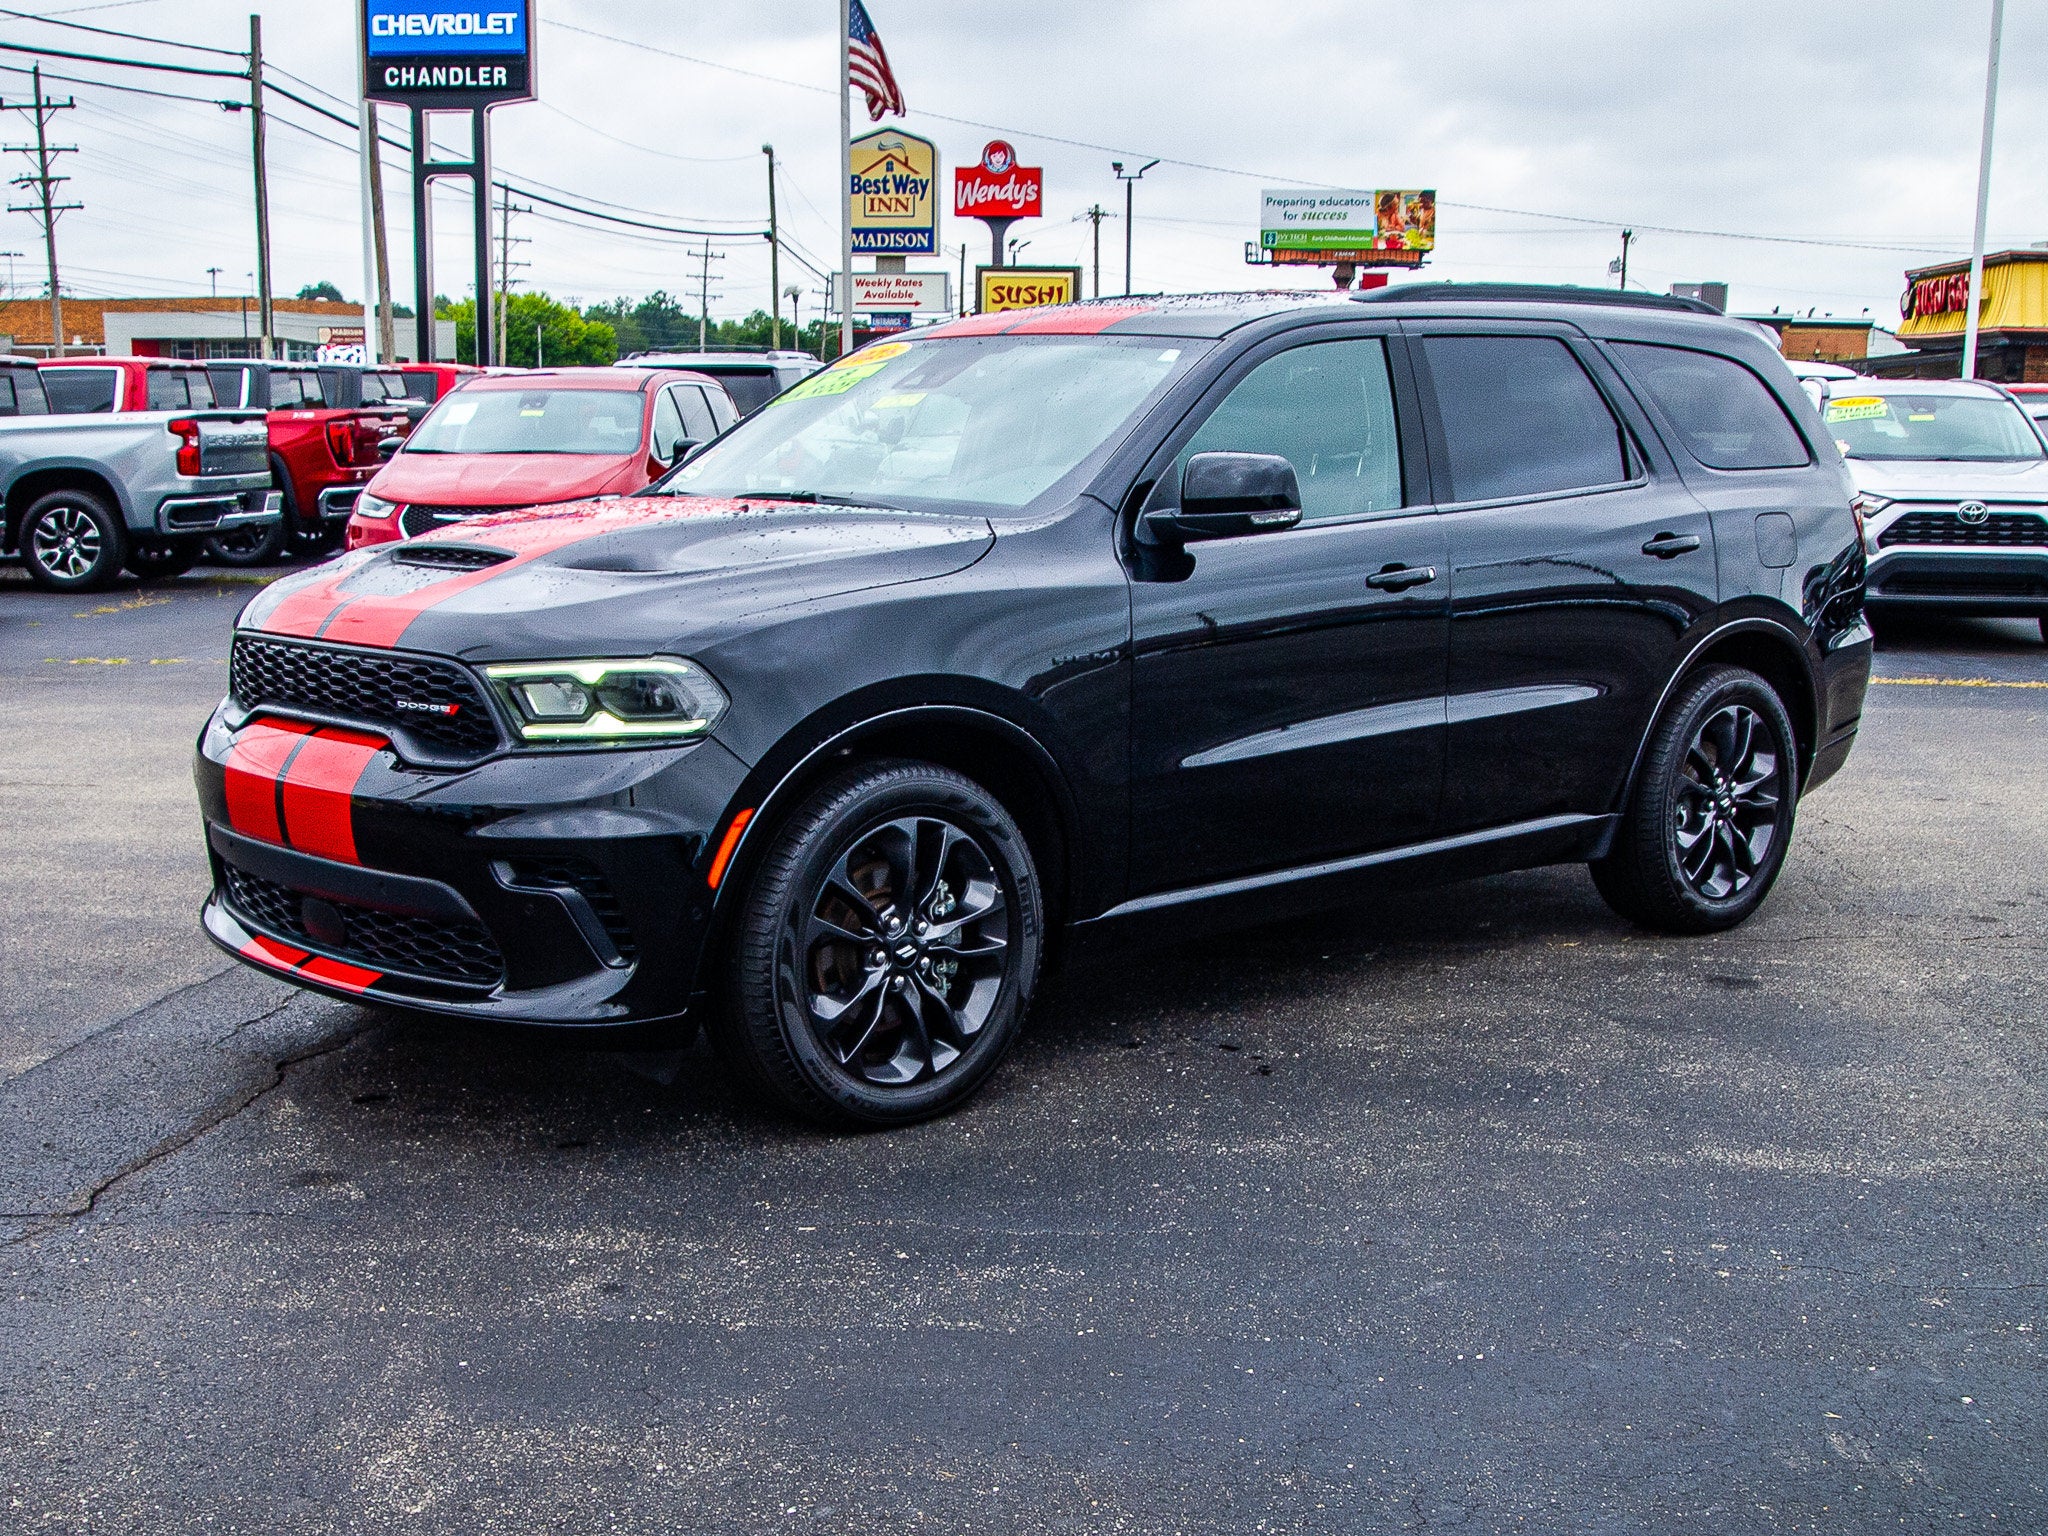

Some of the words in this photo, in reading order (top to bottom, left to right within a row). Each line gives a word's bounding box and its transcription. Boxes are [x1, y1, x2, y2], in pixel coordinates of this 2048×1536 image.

[372, 13, 517, 36] CHEVROLET
[385, 67, 507, 86] CHANDLER
[851, 174, 889, 195] Best
[892, 174, 929, 201] Way
[957, 174, 1038, 209] Wendy's
[868, 197, 911, 212] INN
[1266, 197, 1316, 208] Preparing
[1319, 197, 1371, 207] educators
[1283, 210, 1298, 221] for
[1301, 210, 1348, 221] success
[851, 233, 929, 249] MADISON
[855, 278, 891, 289] Weekly
[895, 278, 923, 288] Rates
[864, 290, 914, 299] Available
[992, 286, 1063, 305] SUSHI
[397, 700, 450, 713] DODGE
